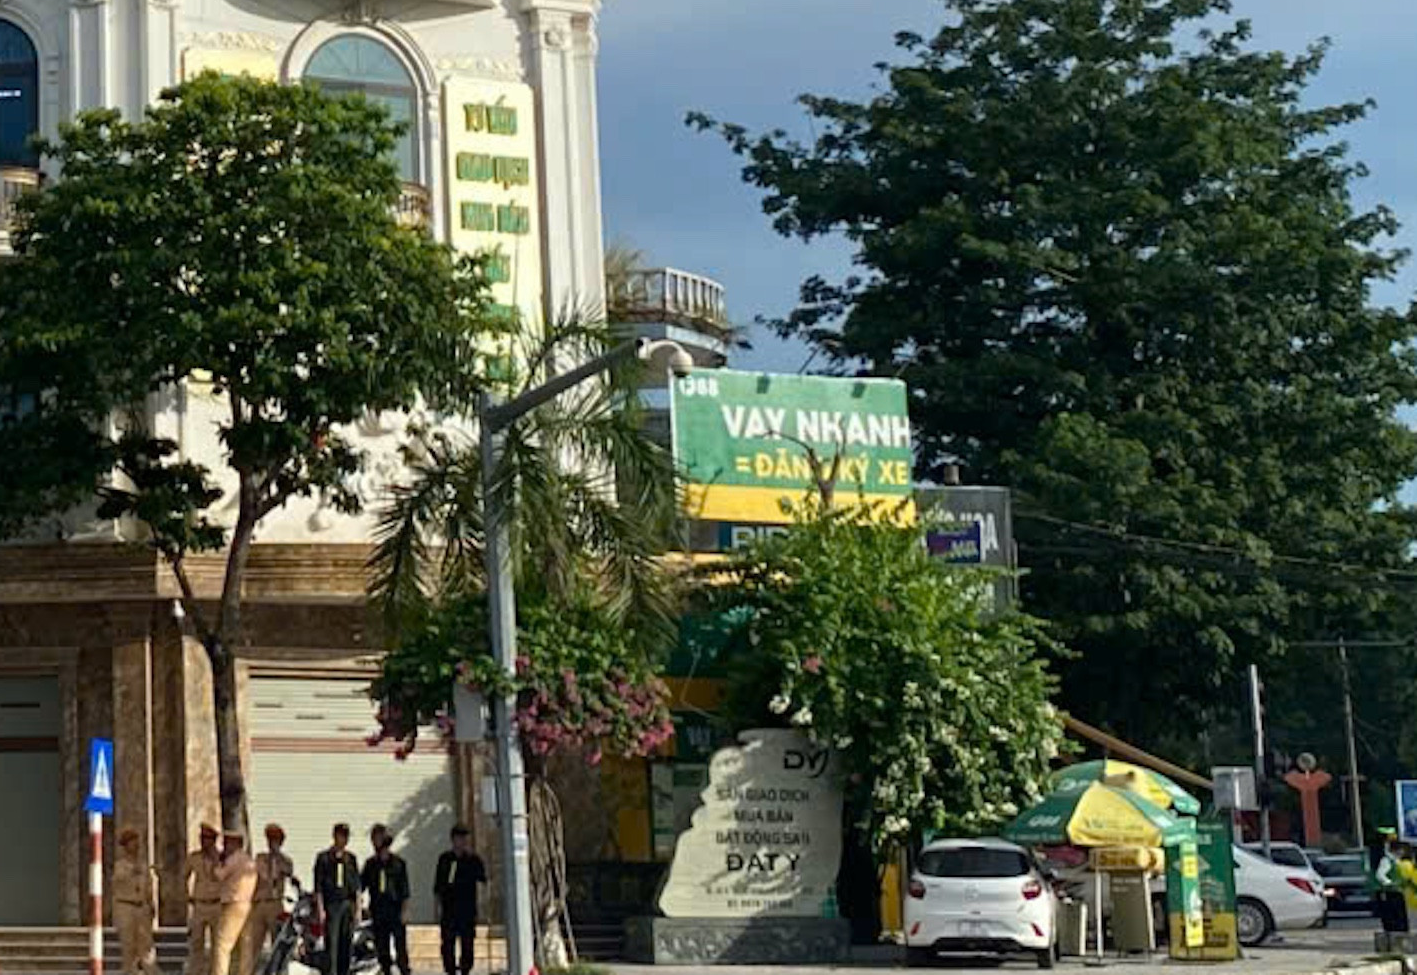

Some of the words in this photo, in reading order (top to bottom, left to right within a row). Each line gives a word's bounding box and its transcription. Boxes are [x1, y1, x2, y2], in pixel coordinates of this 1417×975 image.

[721, 405, 786, 440] VAY
[796, 410, 911, 447] NHANH
[877, 460, 909, 485] XE
